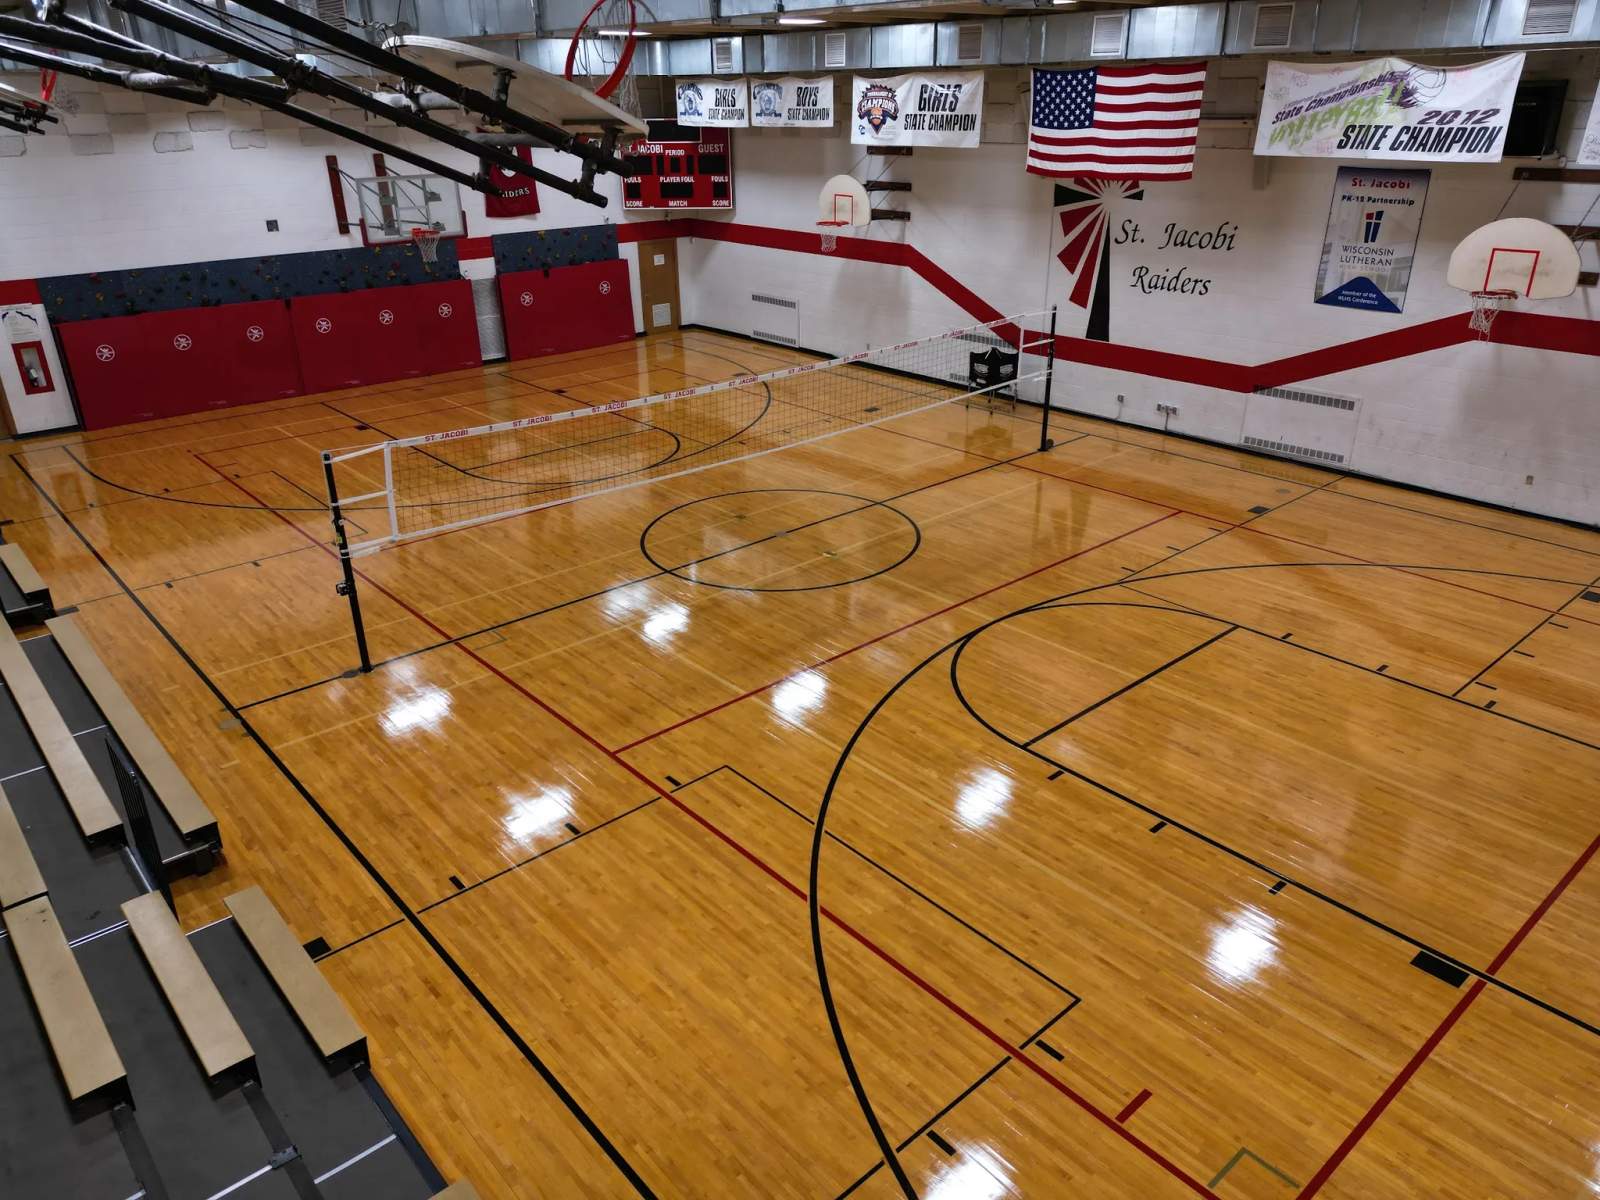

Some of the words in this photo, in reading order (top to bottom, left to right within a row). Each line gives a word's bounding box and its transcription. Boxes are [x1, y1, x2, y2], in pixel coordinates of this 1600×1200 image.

[714, 87, 736, 108] GIRLS
[796, 86, 820, 107] BOYS
[917, 83, 963, 113] GIRLS
[903, 113, 927, 131] STATE
[927, 113, 977, 132] CHAMPION
[1417, 108, 1501, 126] 2012
[1337, 124, 1393, 151] STATE
[1388, 125, 1504, 154] CHAMPION
[697, 144, 725, 153] GUEST
[1351, 177, 1366, 187] St.
[1370, 178, 1411, 190] Jacobi
[669, 199, 688, 207] MATCH
[712, 199, 729, 207] SCORE
[1367, 195, 1415, 207] Partnership
[1114, 218, 1145, 245] St.
[1157, 221, 1239, 251] Jacobi
[1342, 245, 1395, 257] WISCONSIN
[1340, 255, 1393, 267] LUTHERAN
[1130, 265, 1212, 296] Raiders
[604, 401, 628, 412] JACOBI
[512, 420, 522, 428] ST
[527, 415, 552, 425] JACOBI
[425, 434, 435, 442] ST
[440, 429, 469, 440] JACOBI
